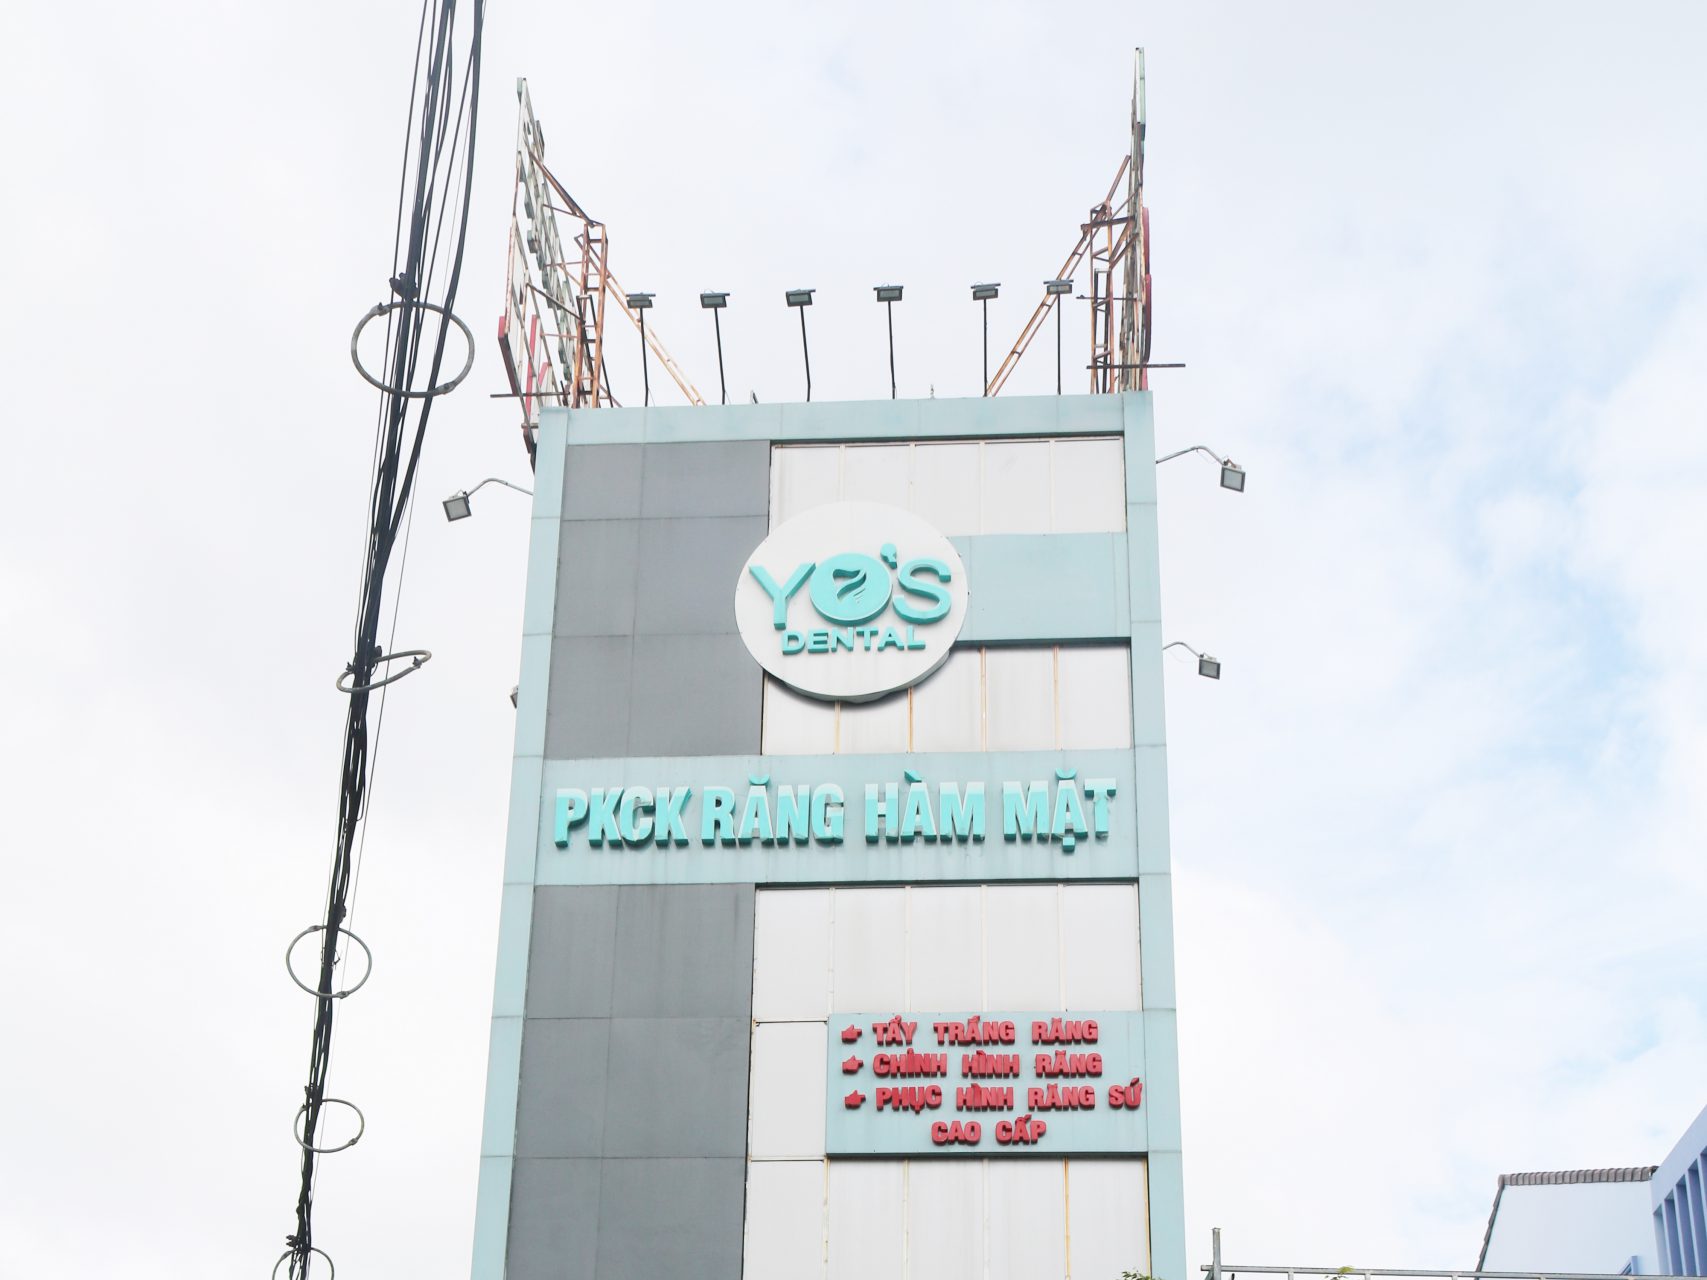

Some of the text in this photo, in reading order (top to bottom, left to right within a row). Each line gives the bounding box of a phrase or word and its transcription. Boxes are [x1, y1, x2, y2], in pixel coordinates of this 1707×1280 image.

[781, 625, 926, 655] DENTAL
[555, 768, 1117, 853] PKCK RĂNG HÀM MẶT
[933, 1016, 1015, 1045] TRẮNG
[1032, 1018, 1098, 1044] RĂNG
[873, 1048, 1102, 1078] CHỈNH HÌNH RĂNG
[876, 1078, 1143, 1114] PHỤC HÌNH RĂNG SỨ
[931, 1114, 1046, 1145] CAO CẤP
